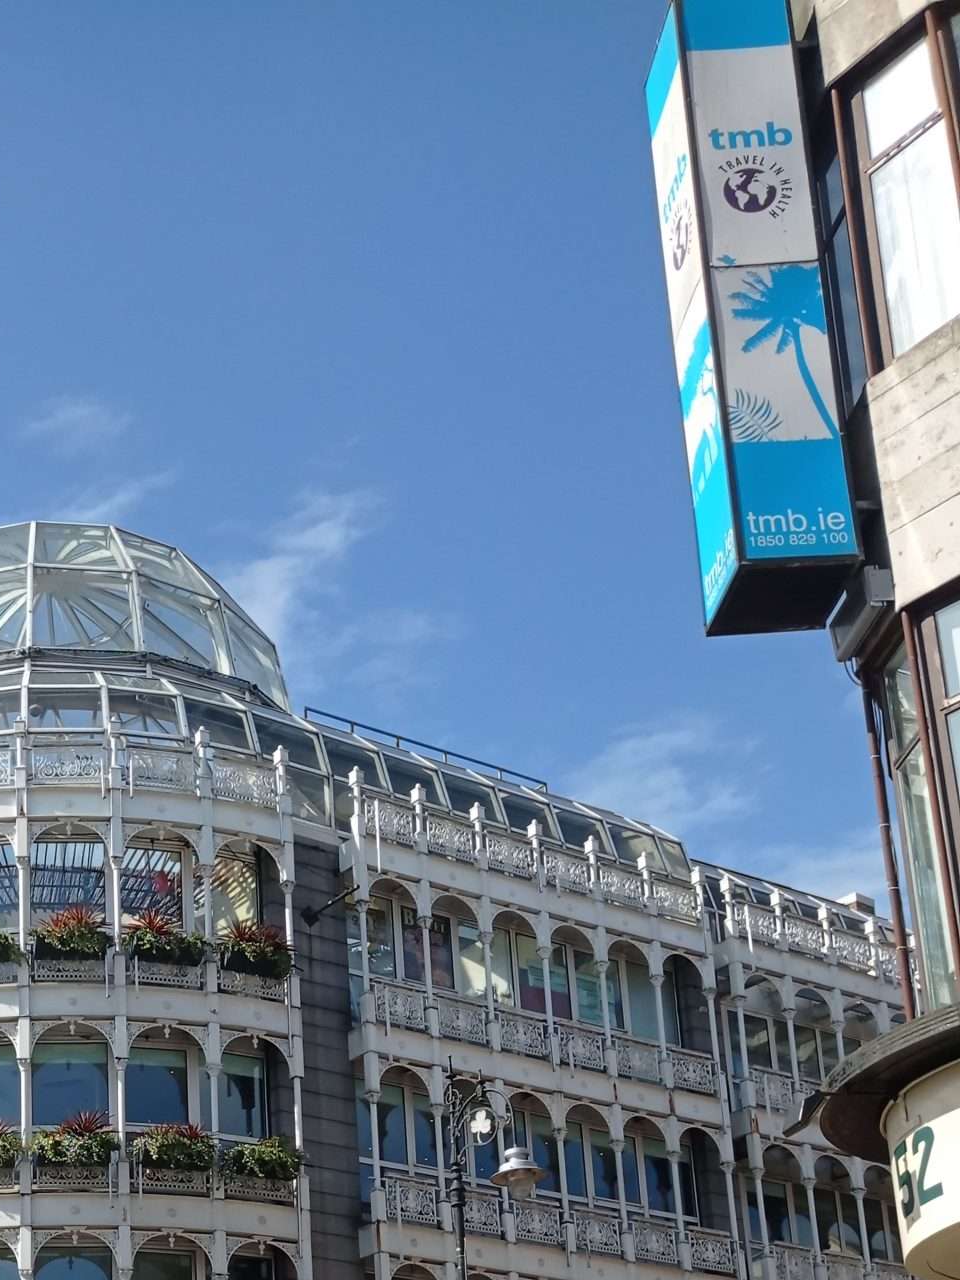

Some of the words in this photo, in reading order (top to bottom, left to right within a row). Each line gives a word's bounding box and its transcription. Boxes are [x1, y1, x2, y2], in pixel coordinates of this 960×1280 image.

[708, 121, 793, 151] tmb
[718, 155, 766, 174] TRAVEL
[769, 162, 785, 176] IN
[767, 178, 793, 220] HEALTH
[746, 506, 846, 533] tmb.ie
[749, 533, 785, 547] 1850
[789, 532, 817, 545] 829
[821, 531, 848, 544] 100
[894, 1125, 944, 1218] 52
